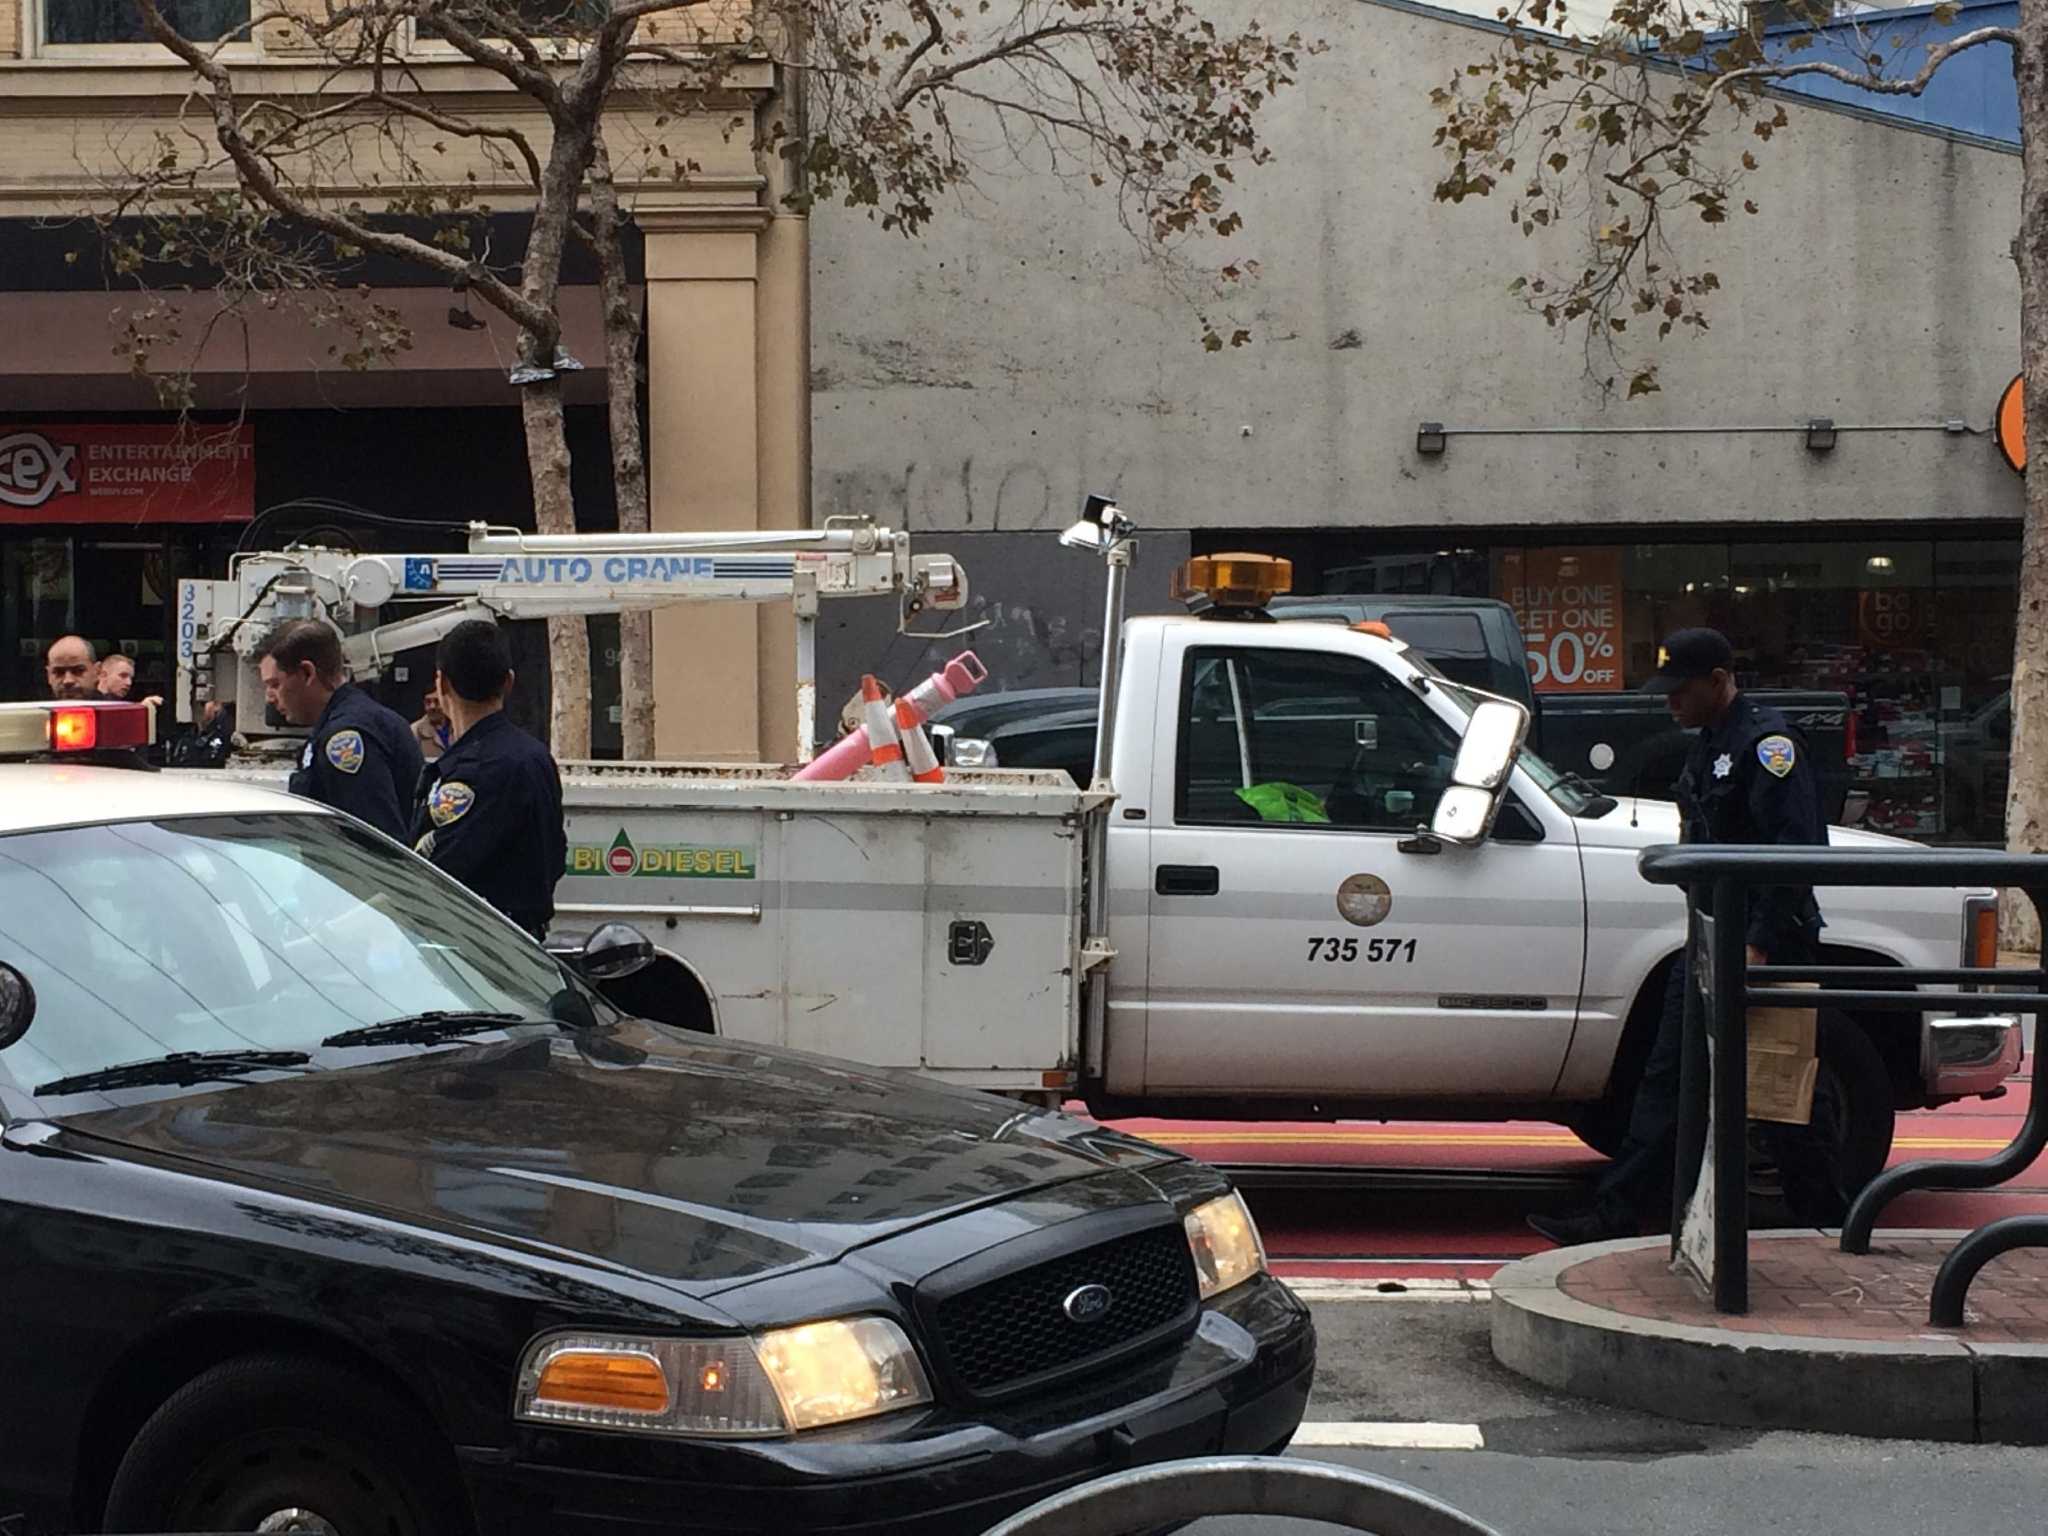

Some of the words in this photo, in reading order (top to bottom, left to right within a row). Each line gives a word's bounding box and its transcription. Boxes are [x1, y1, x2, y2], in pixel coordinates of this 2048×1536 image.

[88, 444, 251, 460] ENTERTAINMENT
[88, 466, 192, 482] EXCHANGE
[500, 557, 593, 583] AUTO
[603, 557, 714, 583] CRANE
[1511, 587, 1558, 606] BUY
[1562, 585, 1614, 605] ONE
[181, 584, 195, 658] 3203
[1514, 610, 1558, 630] GET
[1562, 608, 1614, 628] ONE
[1521, 631, 1614, 684] 50%
[1583, 669, 1615, 684] OFF
[1307, 938, 1358, 962] 735
[1367, 938, 1417, 963] 571
